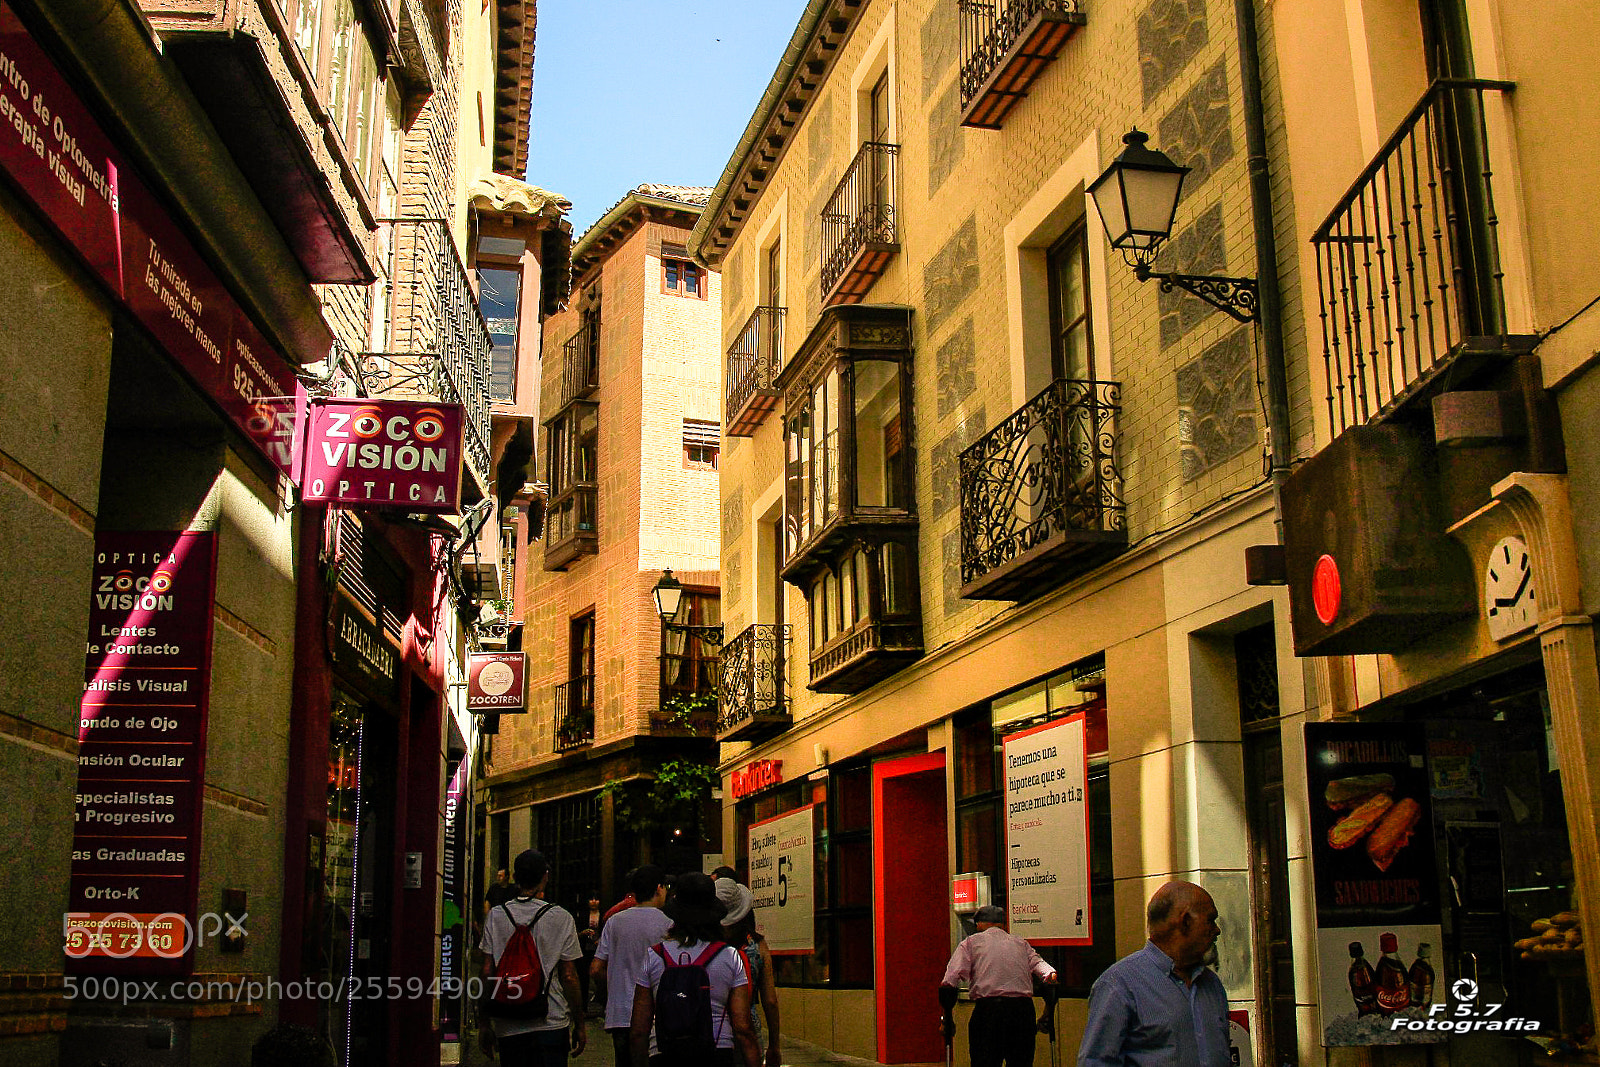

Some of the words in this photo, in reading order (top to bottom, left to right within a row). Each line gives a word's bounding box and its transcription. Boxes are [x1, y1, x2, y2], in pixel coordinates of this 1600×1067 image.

[33, 93, 50, 126] de
[48, 150, 85, 207] visual
[150, 238, 161, 267] Tu
[161, 258, 191, 301] mirada
[191, 295, 202, 317] en
[146, 264, 159, 294] las
[160, 286, 194, 335] mejores
[196, 326, 221, 364] manos
[233, 363, 254, 404] 925
[325, 410, 444, 442] ZOCO
[321, 441, 447, 473] VISIÓN
[98, 575, 172, 592] ZOCO
[96, 591, 173, 611] VISIÓN
[101, 624, 156, 637] Lentes
[104, 642, 180, 655] Contacto
[137, 679, 188, 692] Visual
[470, 696, 520, 704] ZOCOTREN
[80, 716, 120, 729] ondo
[125, 717, 145, 729] de
[150, 717, 178, 731] Ojo
[77, 754, 123, 767] nsión
[129, 754, 184, 767] Ocular
[1009, 750, 1041, 768] Tenemos
[1042, 746, 1057, 760] una
[1009, 775, 1040, 794] hipoteca
[1041, 769, 1055, 787] que
[1057, 767, 1065, 780] se
[75, 791, 174, 806] specialistas
[1009, 800, 1033, 818] parece
[1034, 790, 1060, 809] mucho
[1061, 792, 1067, 803] a
[85, 810, 175, 826] Progresivo
[72, 849, 91, 861] as
[97, 848, 185, 862] Graduadas
[1011, 857, 1040, 872] Hipotecas
[1012, 871, 1057, 890] personalizadas
[84, 886, 140, 900] Orto-K
[89, 933, 112, 948] 25
[119, 933, 142, 949] 73
[148, 934, 172, 949] 60
